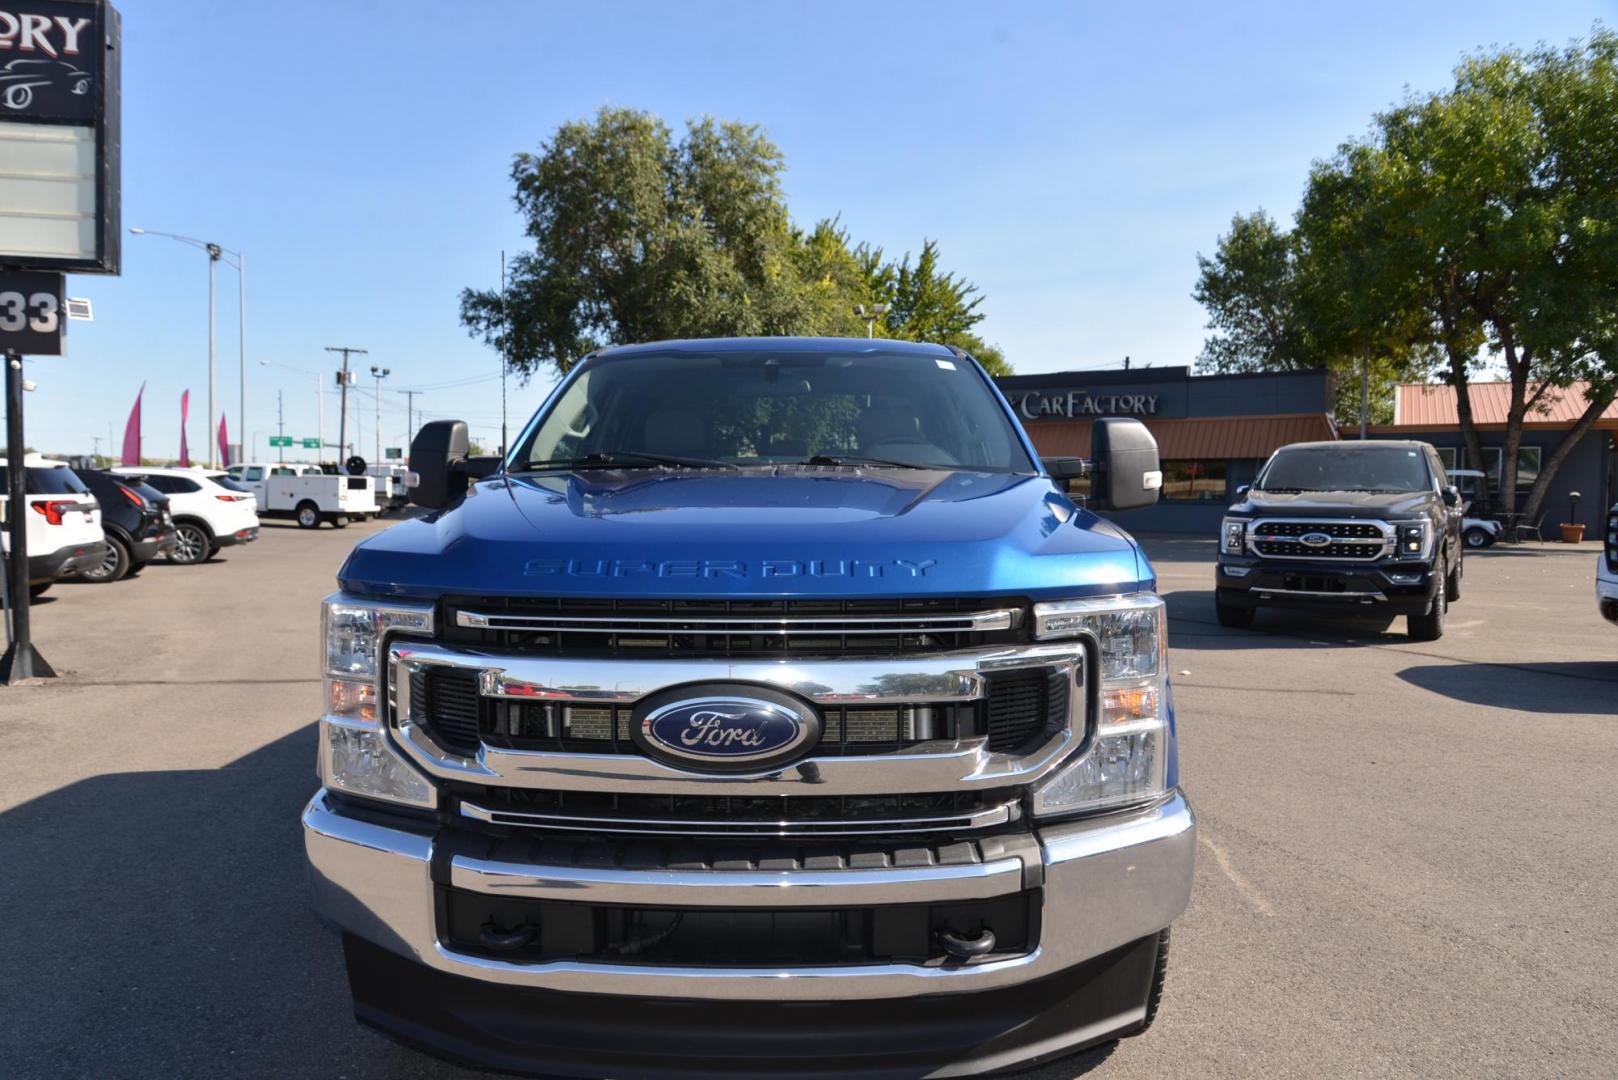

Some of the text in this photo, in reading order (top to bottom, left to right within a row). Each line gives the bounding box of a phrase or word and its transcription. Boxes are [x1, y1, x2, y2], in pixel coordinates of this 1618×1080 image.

[0, 291, 58, 333] 33
[523, 559, 937, 578] SUPER DUTY
[680, 709, 769, 746] Ford
